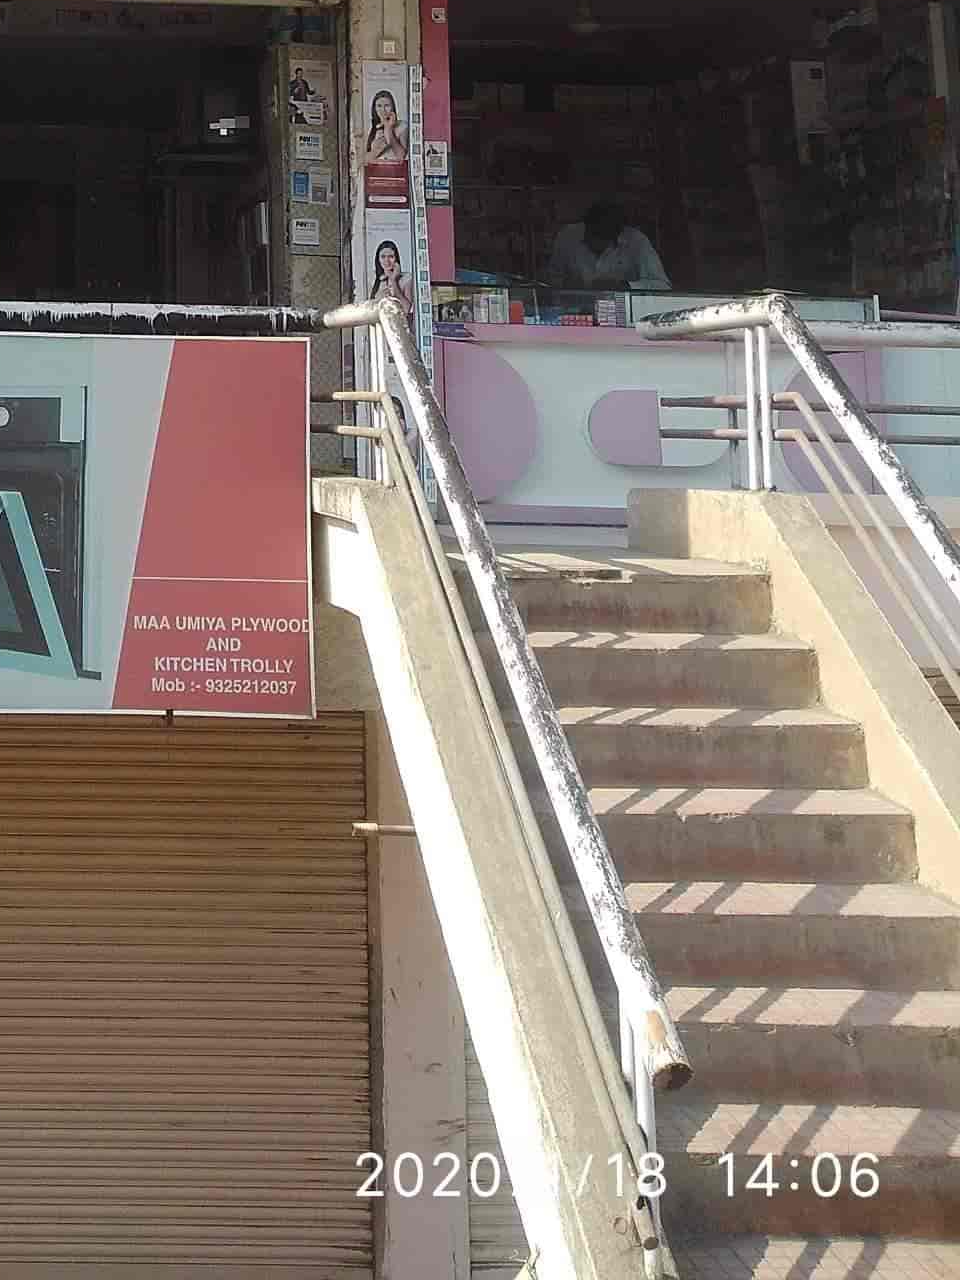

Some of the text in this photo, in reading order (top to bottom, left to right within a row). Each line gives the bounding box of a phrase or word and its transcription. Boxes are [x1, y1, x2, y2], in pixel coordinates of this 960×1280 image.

[134, 615, 171, 630] MAA
[175, 616, 226, 631] UMIYA
[206, 638, 241, 652] AND
[154, 657, 294, 673] KITCHEN TROLLY
[151, 678, 185, 692] Mob
[205, 680, 297, 695] 9325212037
